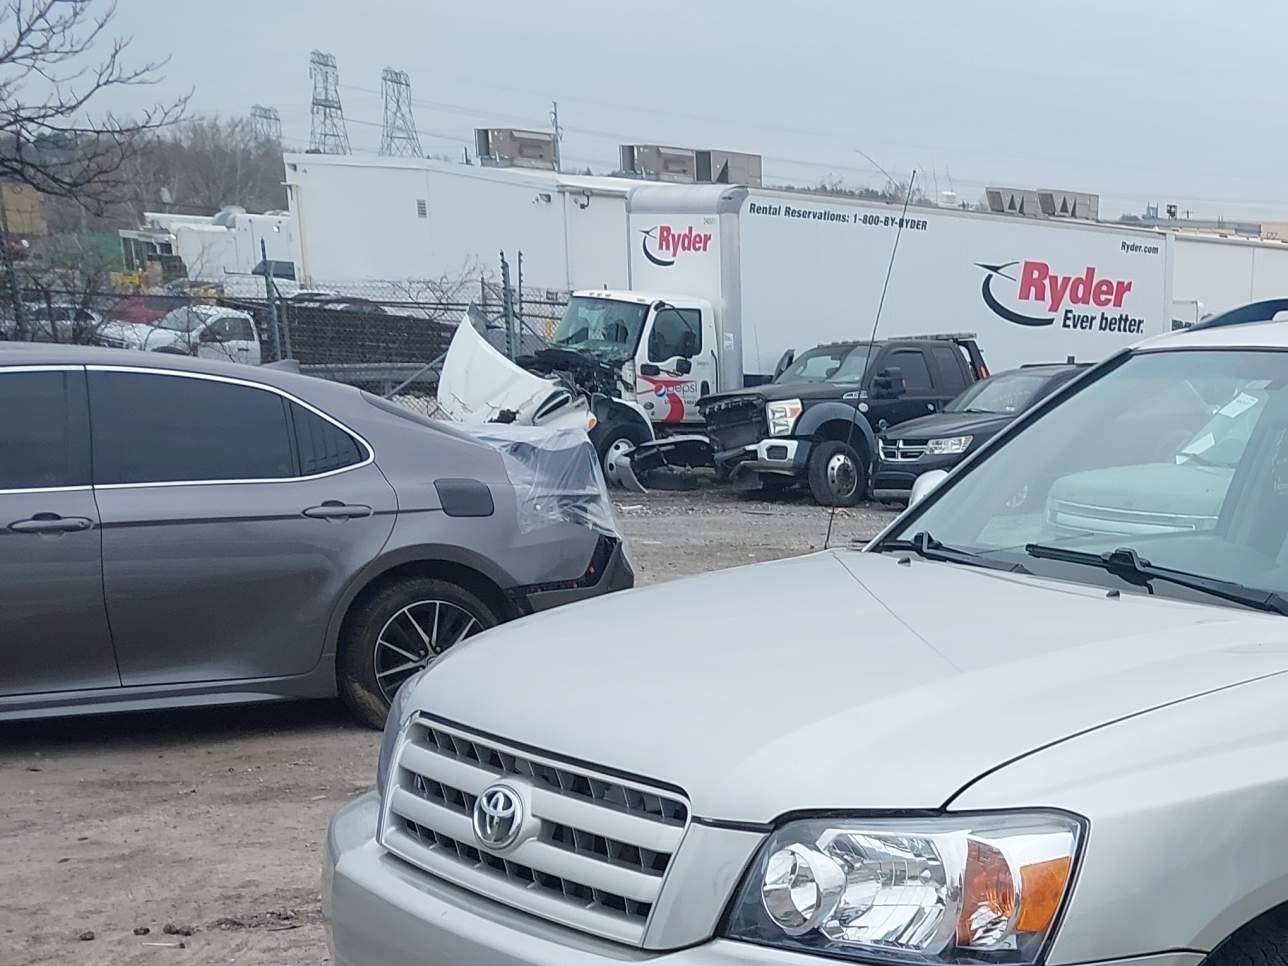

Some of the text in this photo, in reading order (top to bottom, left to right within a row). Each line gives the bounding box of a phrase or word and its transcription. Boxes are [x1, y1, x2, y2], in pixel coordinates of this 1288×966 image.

[749, 202, 782, 217] Rental
[784, 206, 850, 224] Reservations:
[658, 225, 712, 258] Ryder
[1121, 241, 1159, 255] Ryder.com
[1018, 260, 1133, 313] Ryder
[1061, 309, 1145, 334] Ever better.
[666, 383, 698, 395] pepsi
